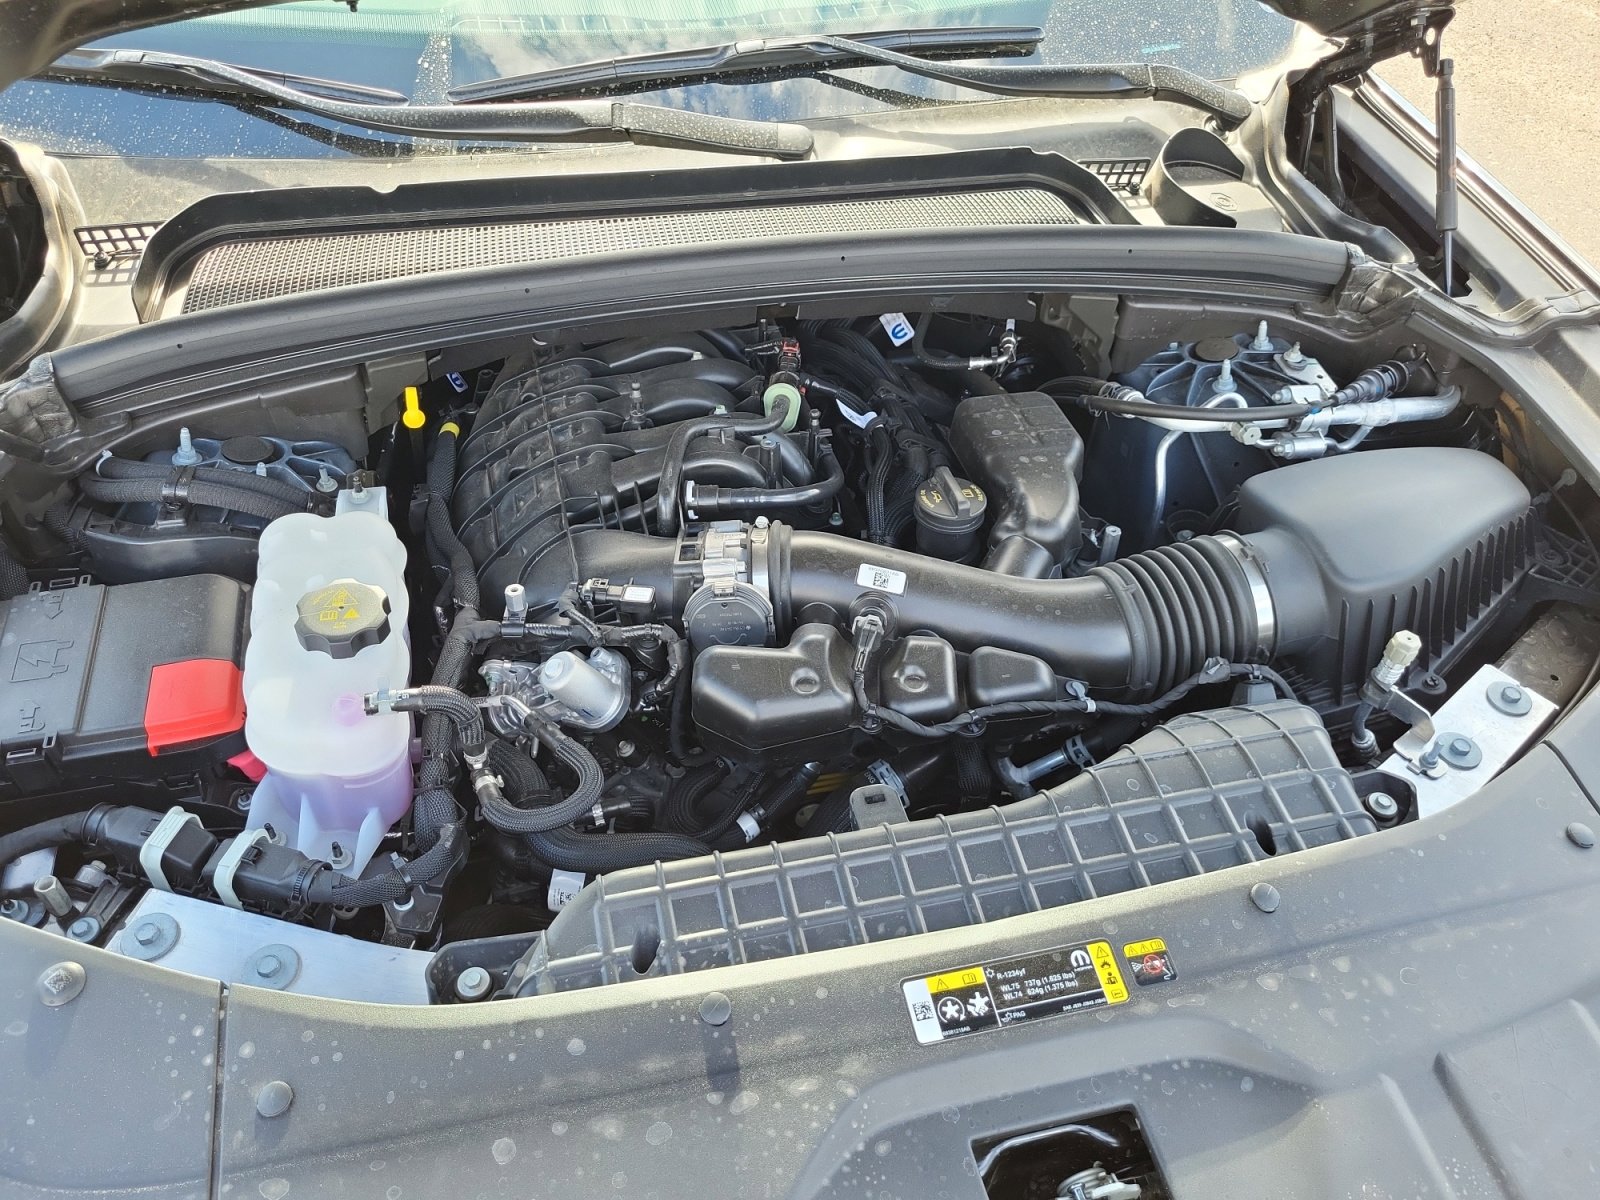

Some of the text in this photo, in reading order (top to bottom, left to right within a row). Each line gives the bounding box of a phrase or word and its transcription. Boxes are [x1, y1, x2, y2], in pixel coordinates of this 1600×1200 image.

[1000, 983, 1020, 993] WL75
[1024, 977, 1042, 987] 737g
[1062, 971, 1076, 981] lbs)
[1003, 991, 1023, 1001] WL74
[1044, 982, 1065, 993] (1.375
[1065, 979, 1079, 989] lbs)
